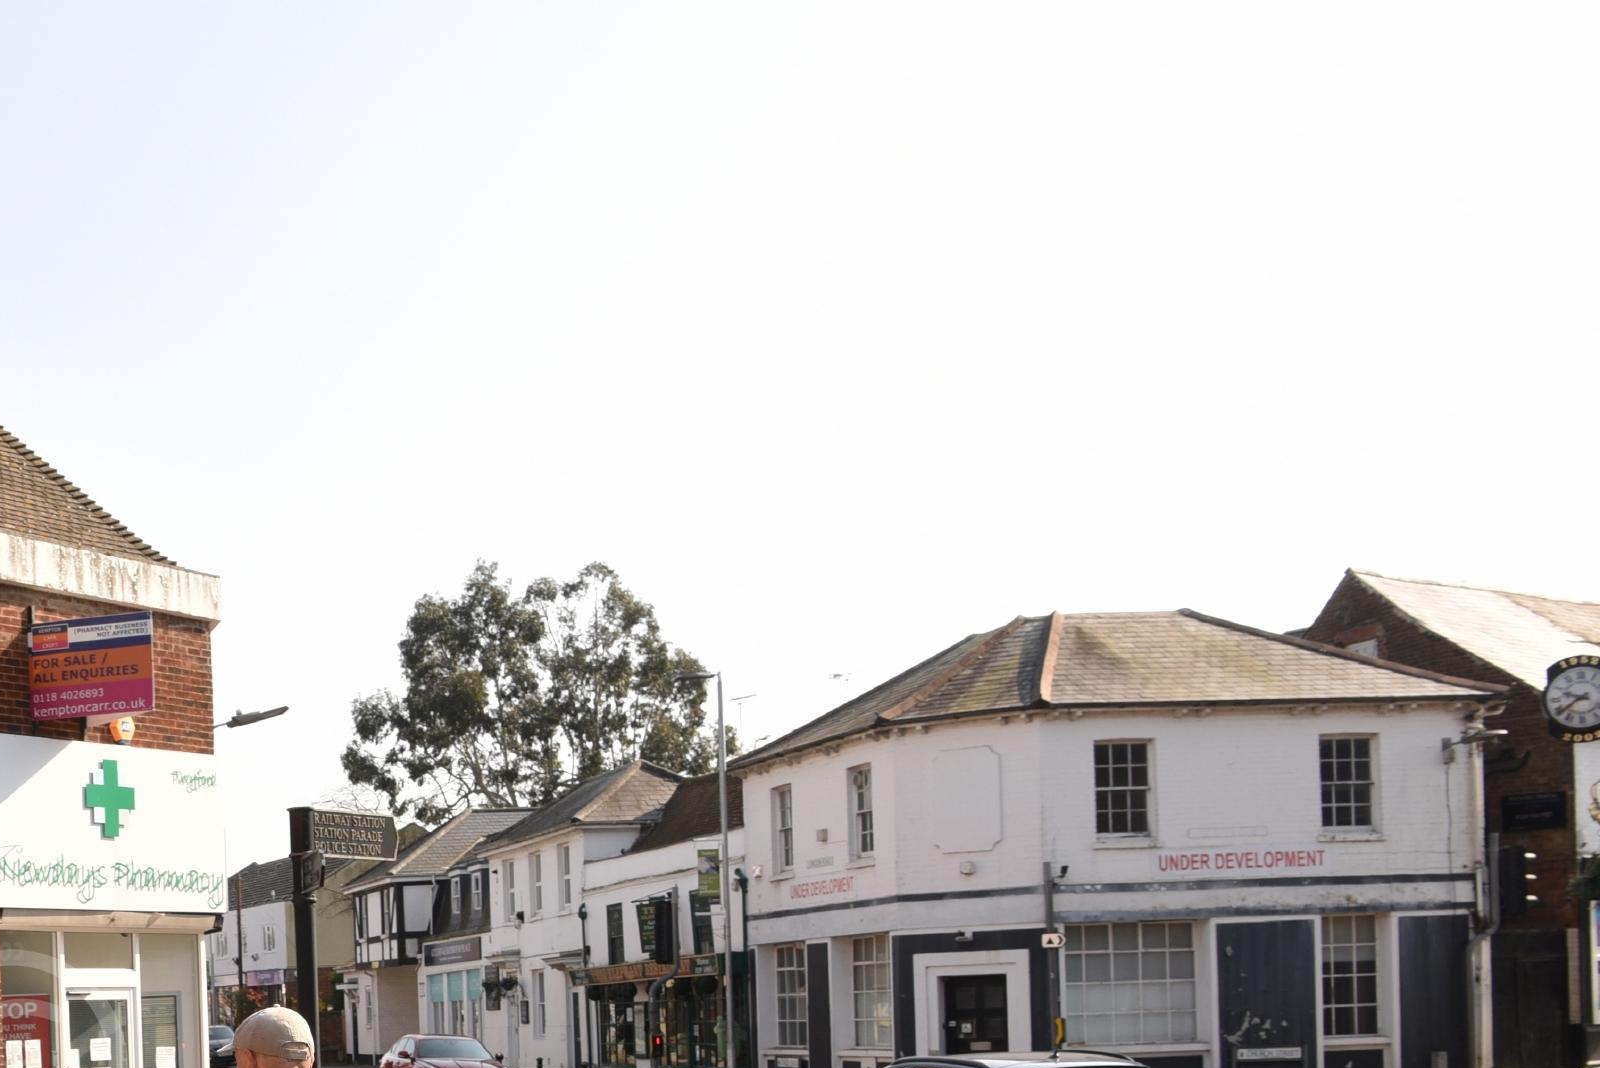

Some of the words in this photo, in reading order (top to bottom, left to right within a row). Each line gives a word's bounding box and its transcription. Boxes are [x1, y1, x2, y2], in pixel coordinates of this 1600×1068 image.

[33, 658, 59, 670] FOR
[64, 654, 97, 667] SALE
[1559, 656, 1600, 670] 1952
[34, 672, 57, 683] ALL
[61, 664, 139, 681] ENQUIRIES
[33, 692, 58, 703] 0118
[61, 687, 105, 701] 4026893
[33, 697, 147, 718] kemptoncarr.co.uk
[314, 812, 351, 827] RAILWAY
[352, 815, 386, 829] STATION
[314, 826, 349, 840] STATION
[351, 829, 384, 842] PARADE
[314, 840, 347, 854] POLICE
[348, 842, 382, 856] STATION
[1158, 853, 1210, 872] UNDER
[1215, 850, 1326, 870] DEVELOPMENT
[112, 859, 224, 909] Pharmacy
[811, 876, 854, 896] DEVELOPMENT
